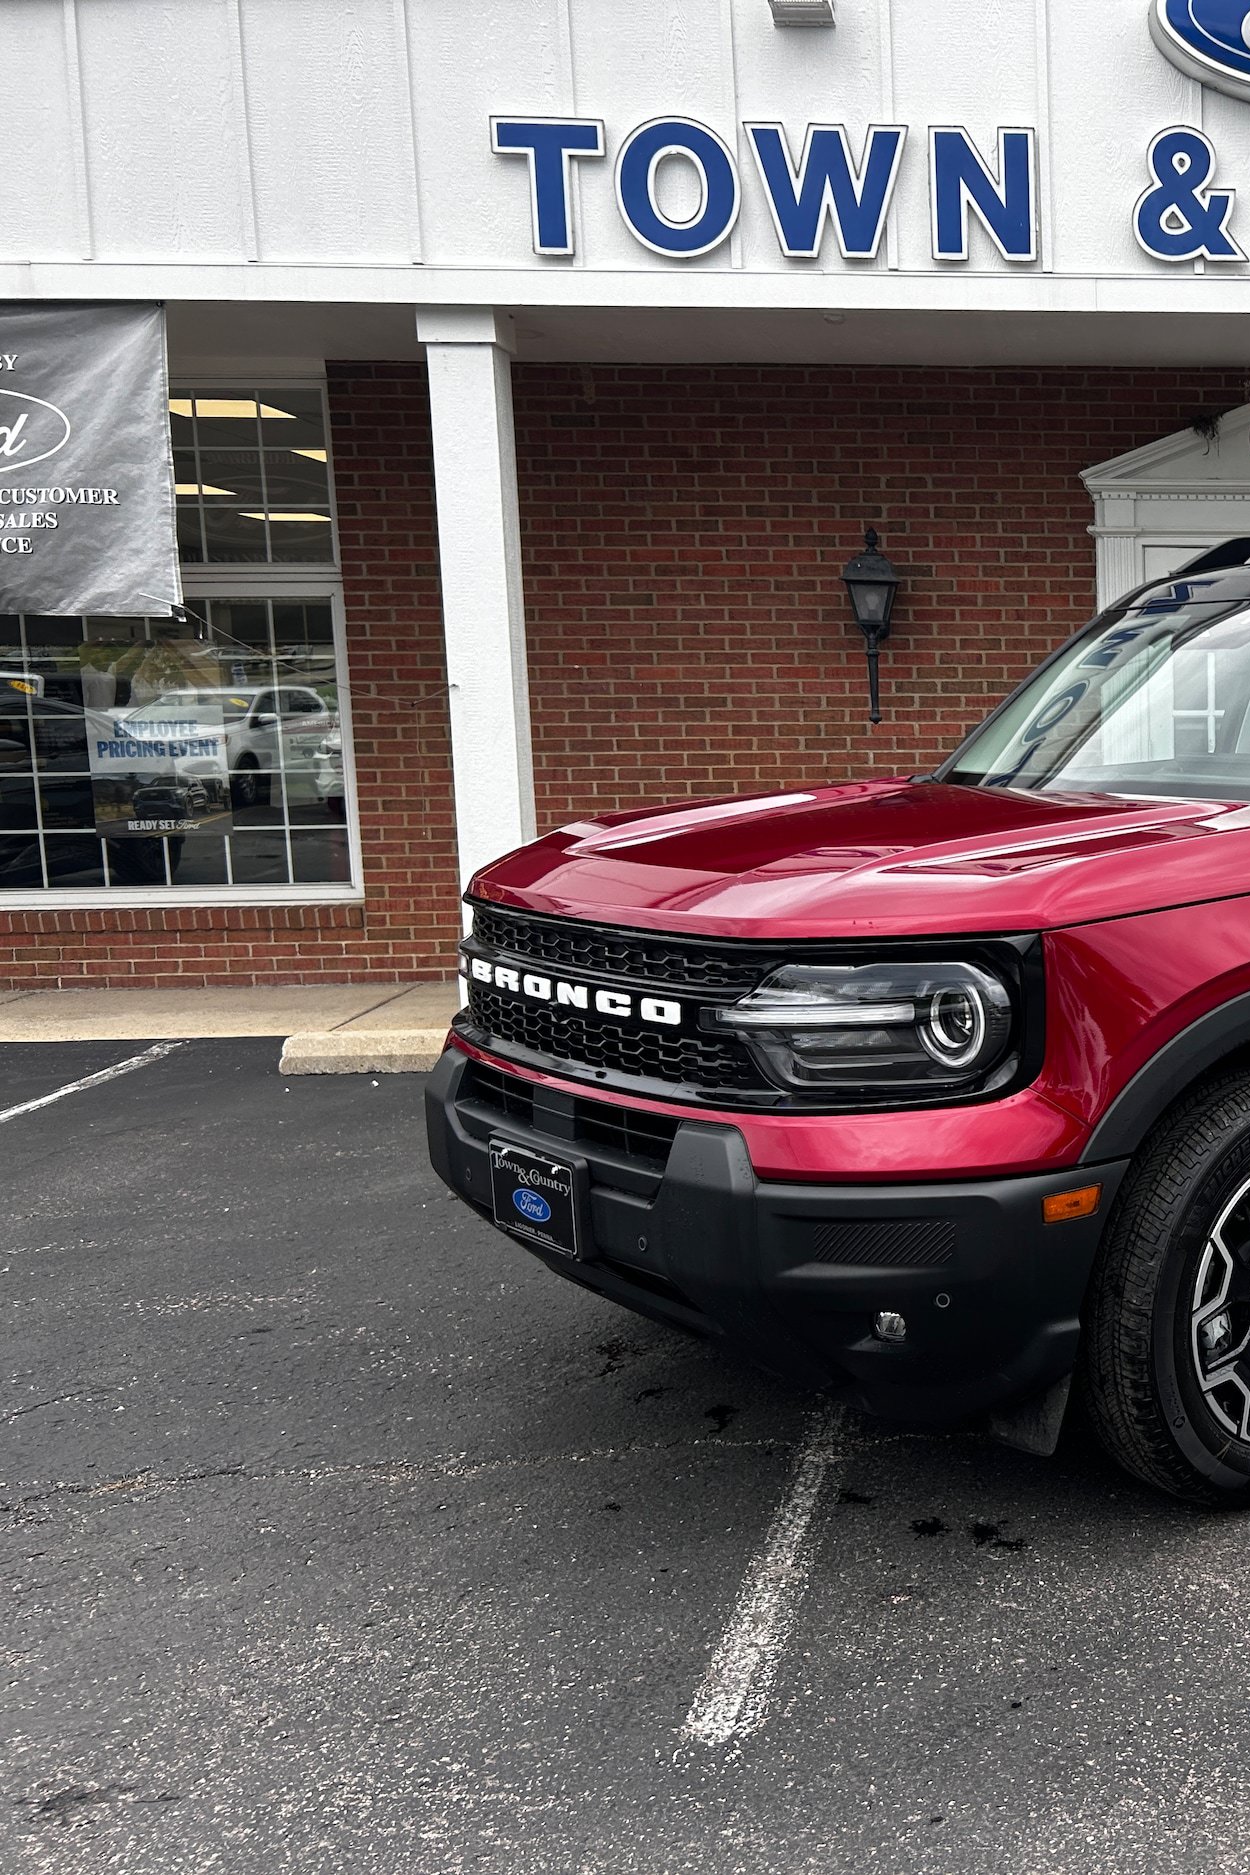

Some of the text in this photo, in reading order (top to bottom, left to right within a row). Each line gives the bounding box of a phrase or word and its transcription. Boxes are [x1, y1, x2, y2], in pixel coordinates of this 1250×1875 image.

[489, 115, 1038, 262] TOWN
[1133, 125, 1249, 264] &
[0, 487, 121, 506] CUSTOMER
[113, 720, 199, 738] EMPLOYEE
[97, 738, 220, 758] PRICING EVENT
[128, 820, 158, 831] READY
[159, 820, 175, 831] SET
[471, 957, 682, 1026] BRONCO
[490, 1150, 521, 1174] Town
[518, 1168, 571, 1197] & Country
[520, 1191, 544, 1217] Ford
